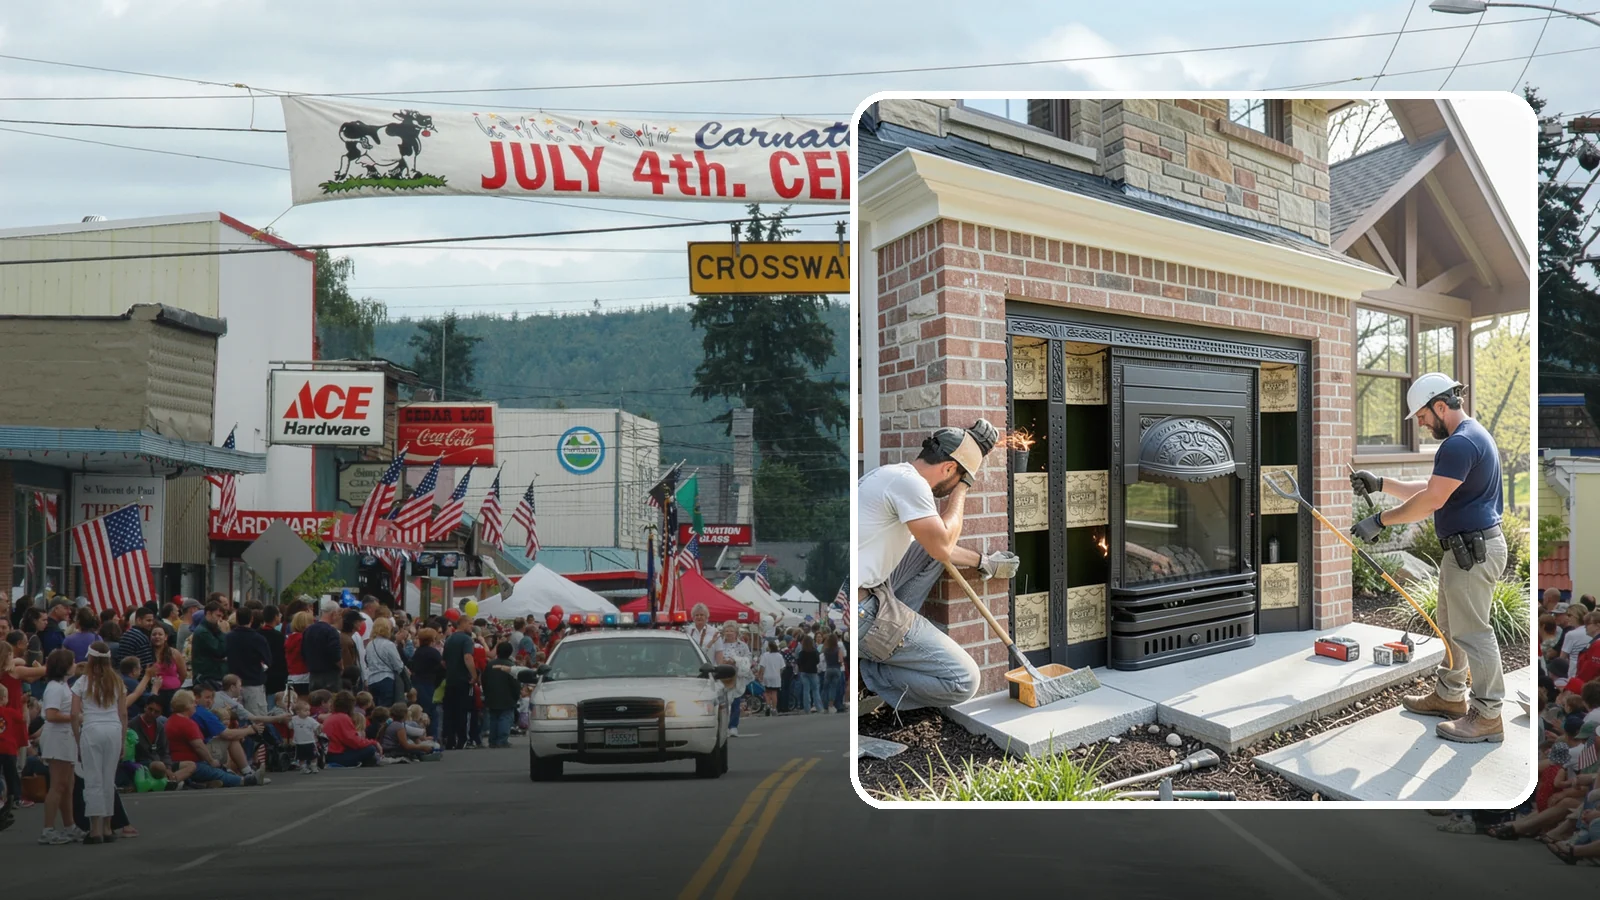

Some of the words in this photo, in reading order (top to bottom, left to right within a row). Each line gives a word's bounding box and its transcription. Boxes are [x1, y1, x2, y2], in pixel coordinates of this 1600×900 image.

[481, 141, 605, 192] JULY
[632, 150, 746, 197] 4th.
[697, 254, 850, 280] CROSSWA
[282, 380, 374, 419] ACE
[406, 409, 452, 422] CEDAR
[461, 409, 485, 421] LOG
[283, 421, 371, 436] Hardware
[416, 428, 477, 447] Coca-Cola
[353, 467, 385, 480] Simpl
[96, 485, 124, 495] Vincent
[126, 486, 135, 495] de
[138, 486, 155, 495] Paul
[688, 526, 741, 535] CRNATION
